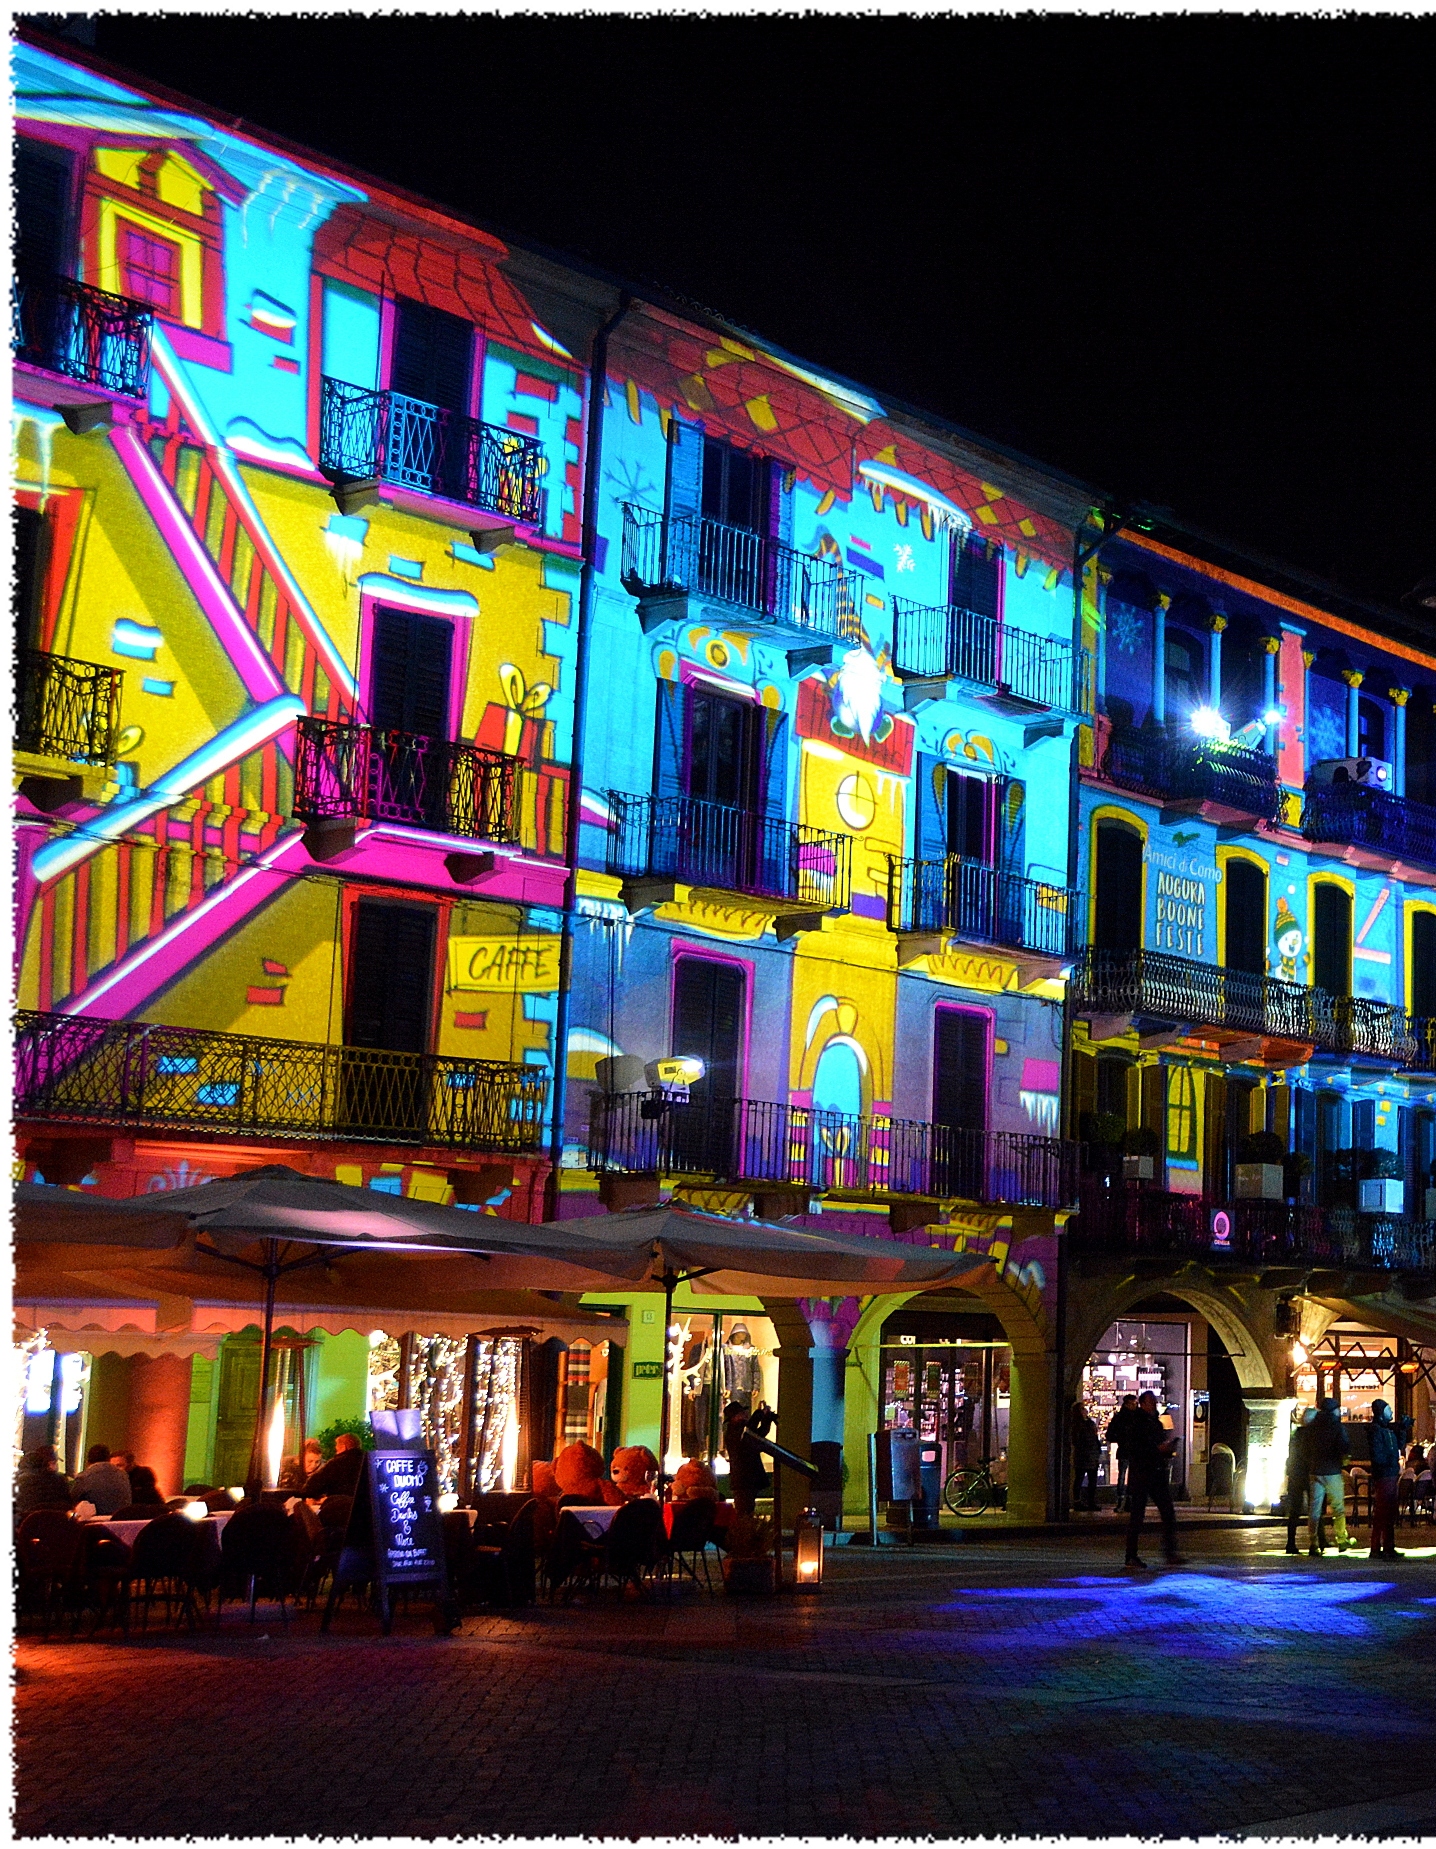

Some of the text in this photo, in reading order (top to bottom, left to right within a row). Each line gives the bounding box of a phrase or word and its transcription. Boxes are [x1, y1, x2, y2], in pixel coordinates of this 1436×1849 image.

[1142, 844, 1222, 883] Amici di Como
[1157, 871, 1205, 905] AUGURA
[1157, 897, 1204, 931] BUONE
[1156, 921, 1203, 956] FESTE
[386, 1459, 414, 1474] CAFFE
[393, 1475, 424, 1488] DUOMO
[390, 1491, 415, 1508] Coffee
